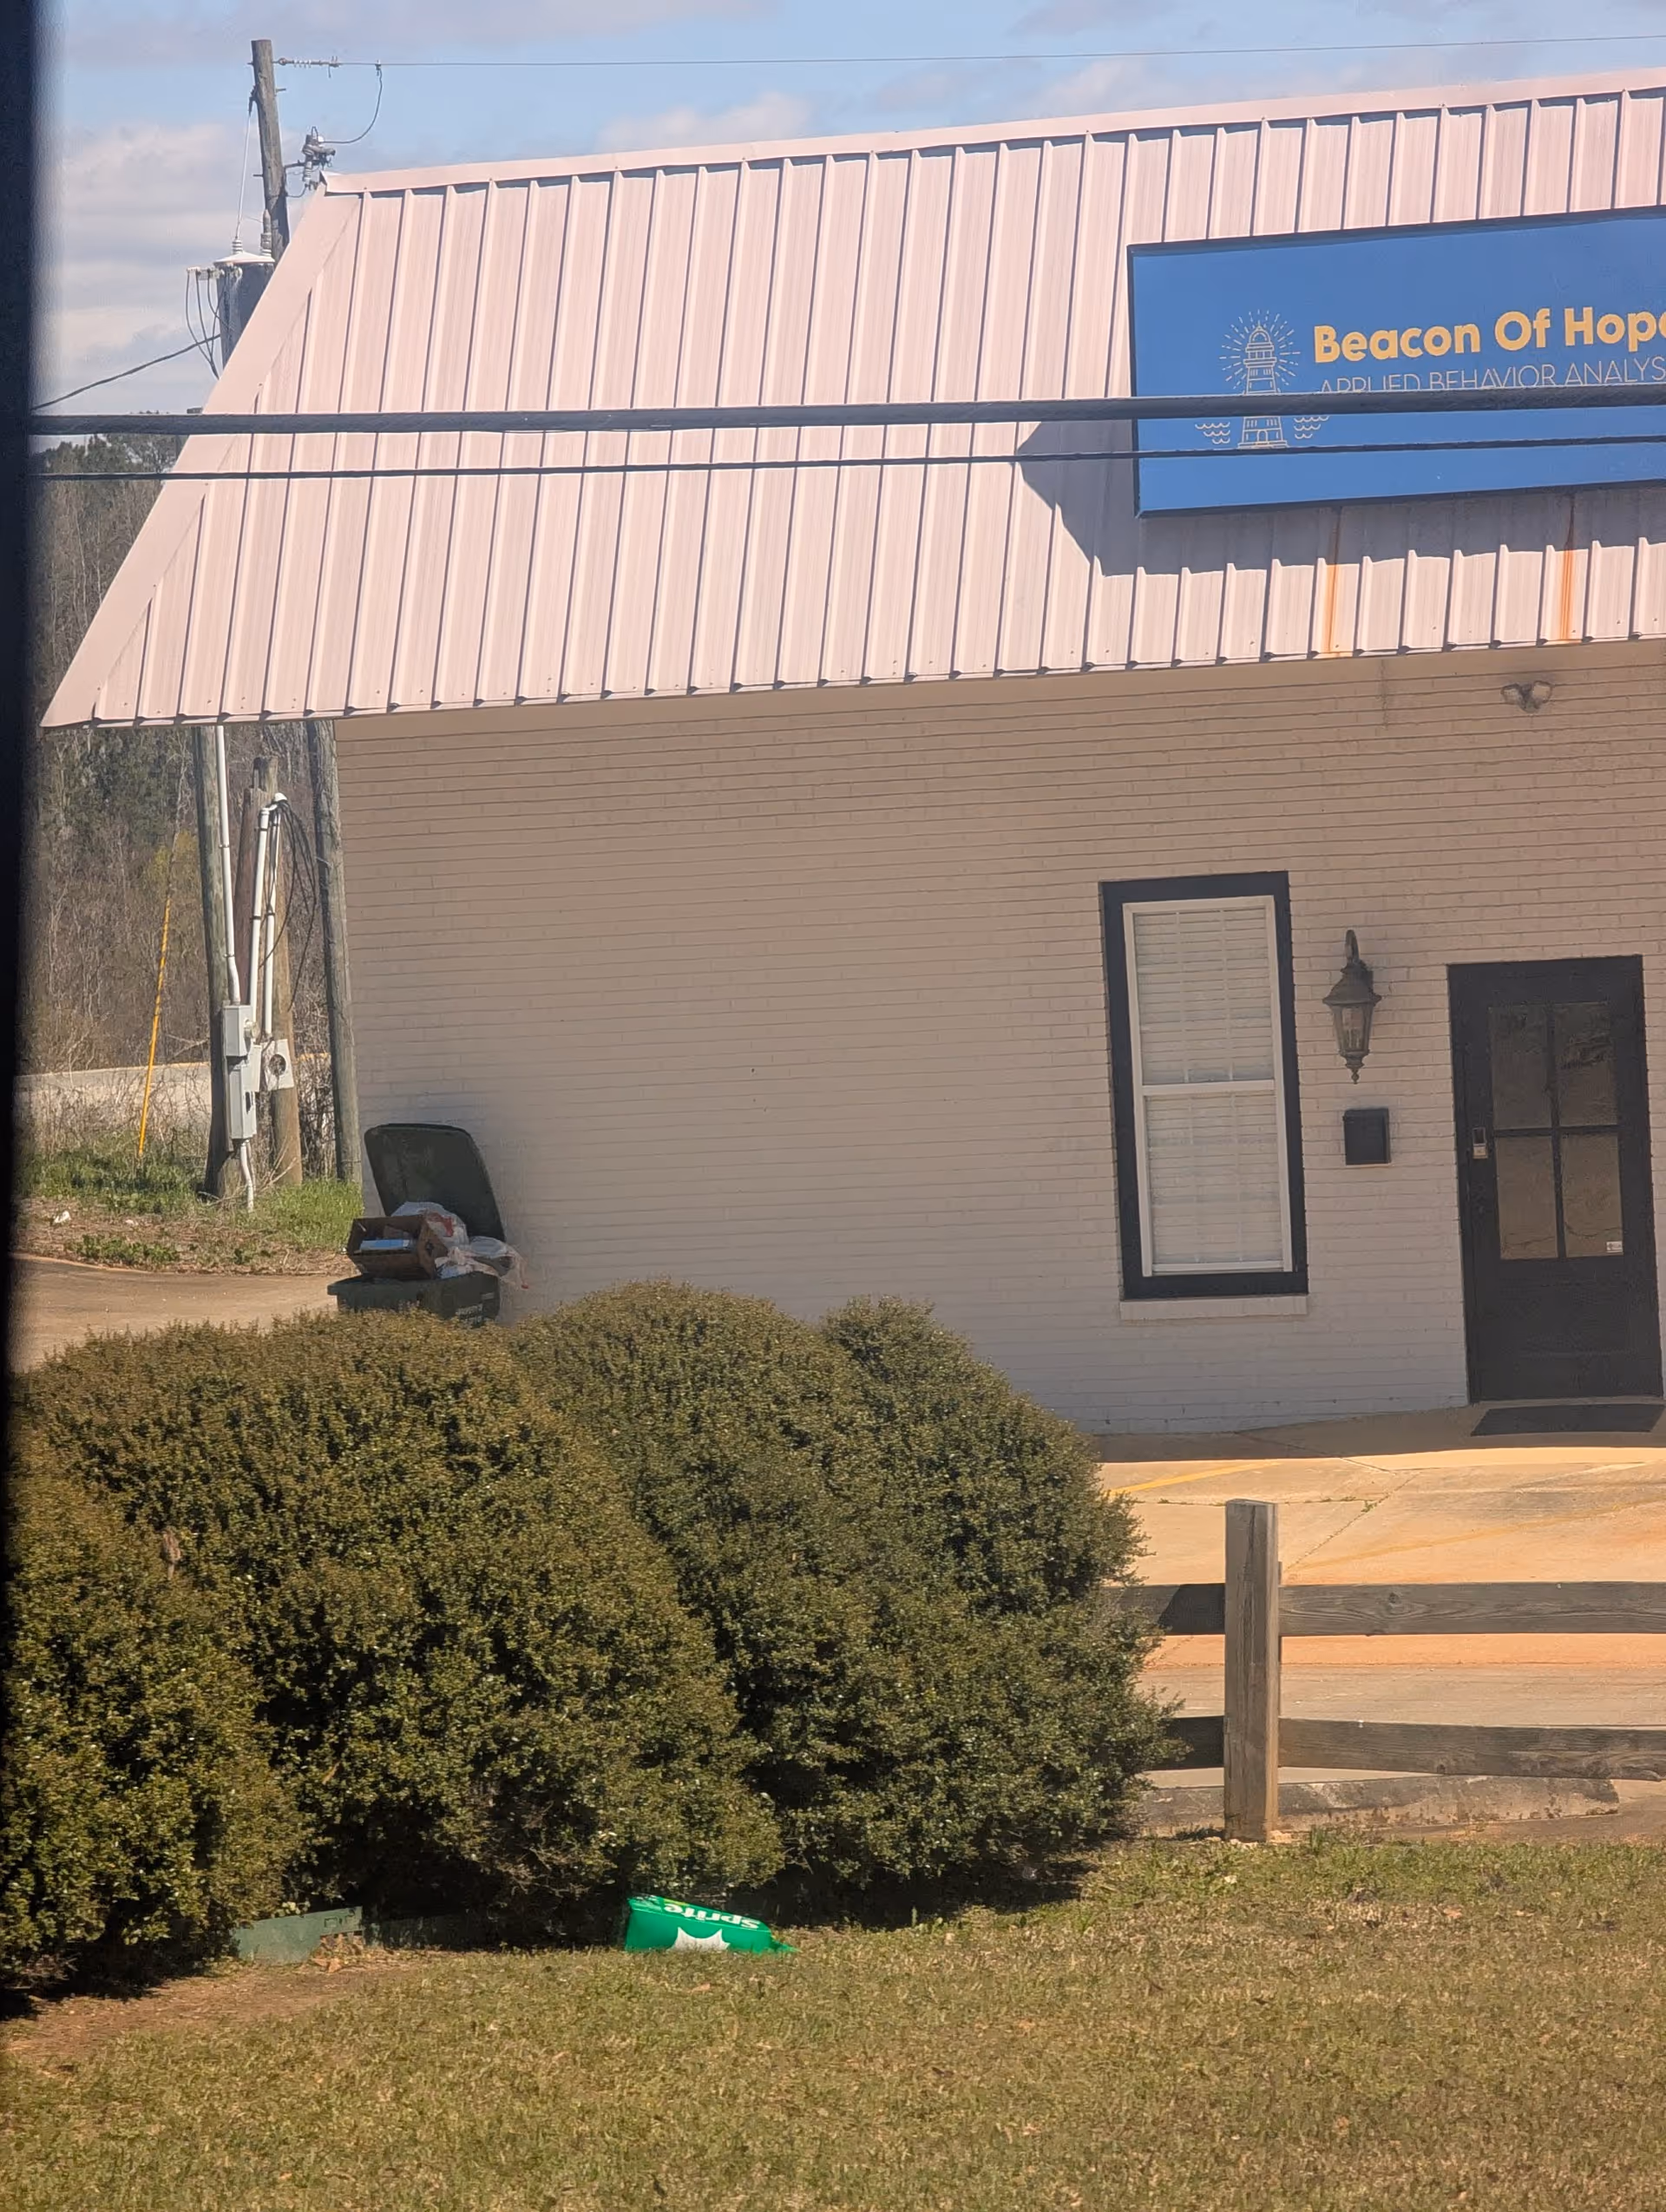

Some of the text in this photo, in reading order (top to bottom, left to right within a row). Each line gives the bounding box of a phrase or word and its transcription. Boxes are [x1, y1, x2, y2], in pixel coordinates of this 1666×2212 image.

[1314, 306, 1666, 363] Beacon Of Hop
[1429, 364, 1557, 390] BEHAVIOR
[664, 1904, 761, 1928] Sprite
